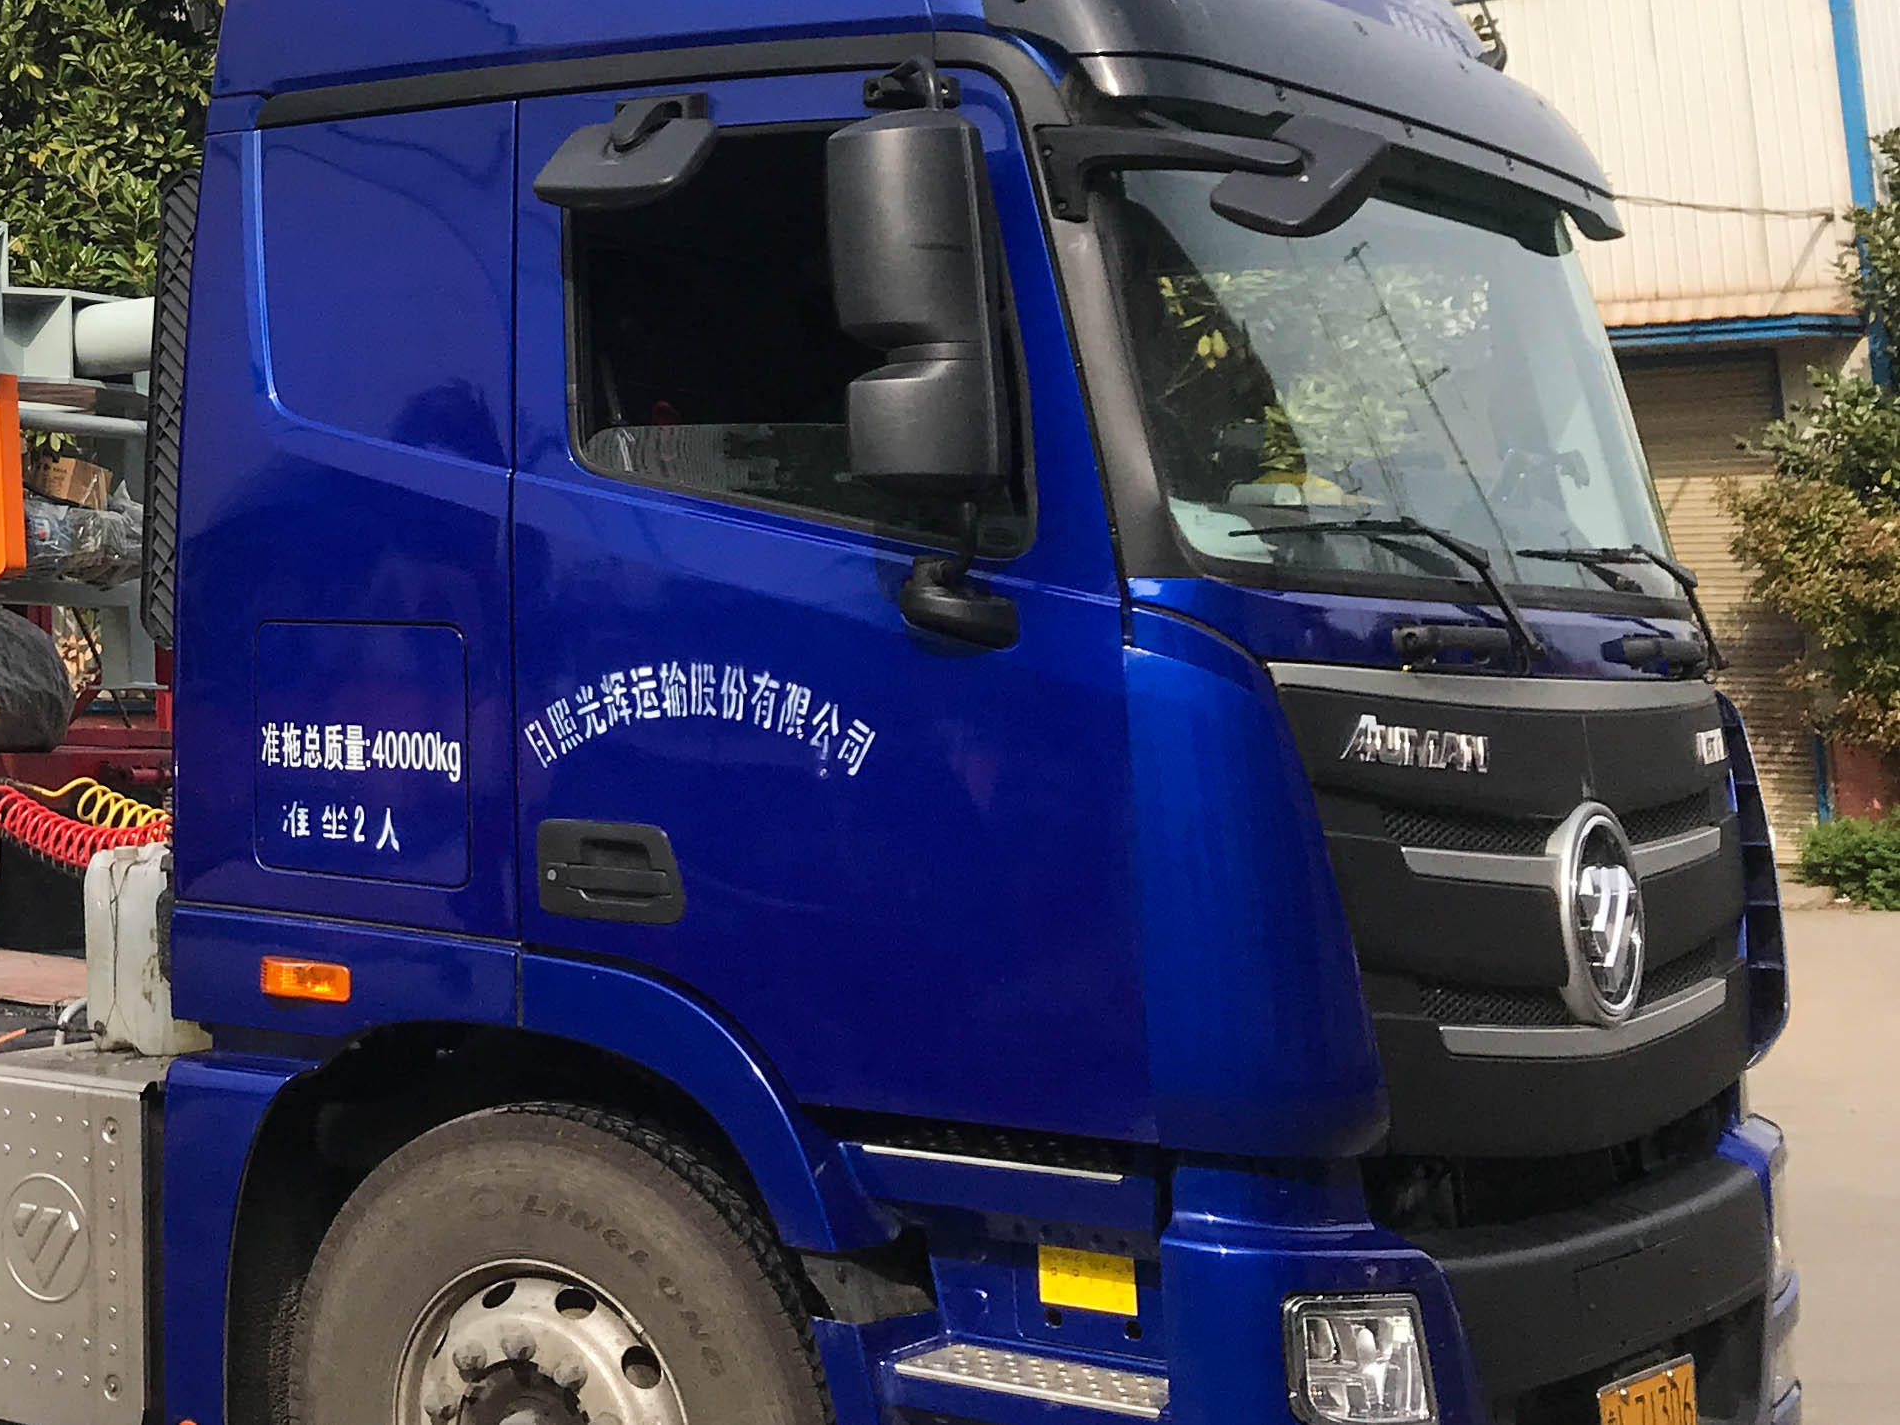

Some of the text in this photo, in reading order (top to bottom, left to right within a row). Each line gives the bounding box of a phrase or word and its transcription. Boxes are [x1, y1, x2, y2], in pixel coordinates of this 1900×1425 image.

[523, 661, 877, 777] 日照光辉运输股份有限公司
